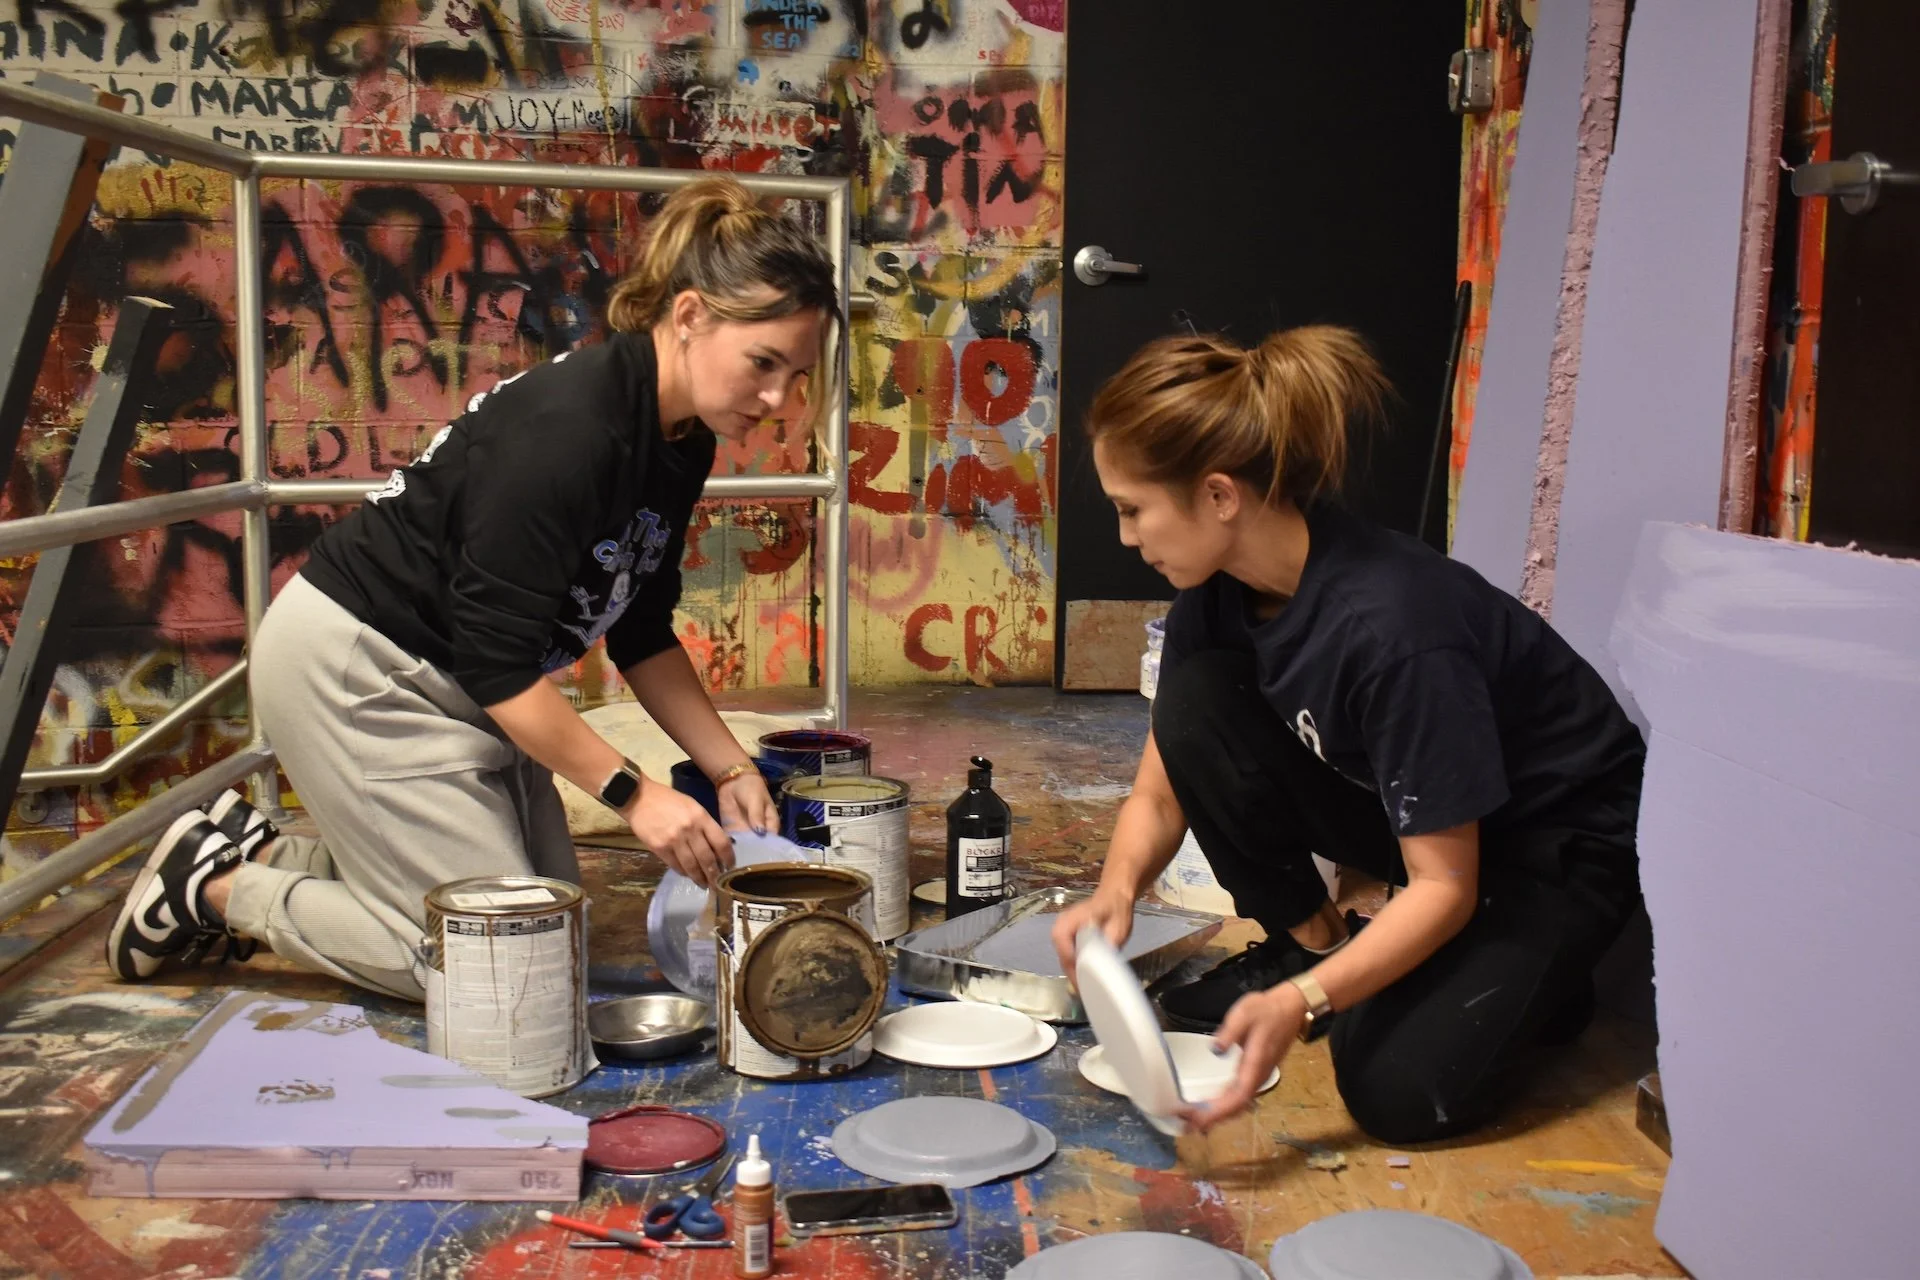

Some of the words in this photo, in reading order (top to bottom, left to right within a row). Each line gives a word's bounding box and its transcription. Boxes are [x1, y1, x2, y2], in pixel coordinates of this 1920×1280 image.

[779, 14, 817, 32] THE
[761, 32, 801, 49] SEA
[191, 77, 352, 122] MARIA
[495, 96, 561, 140] JOY
[520, 1170, 562, 1190] 250
